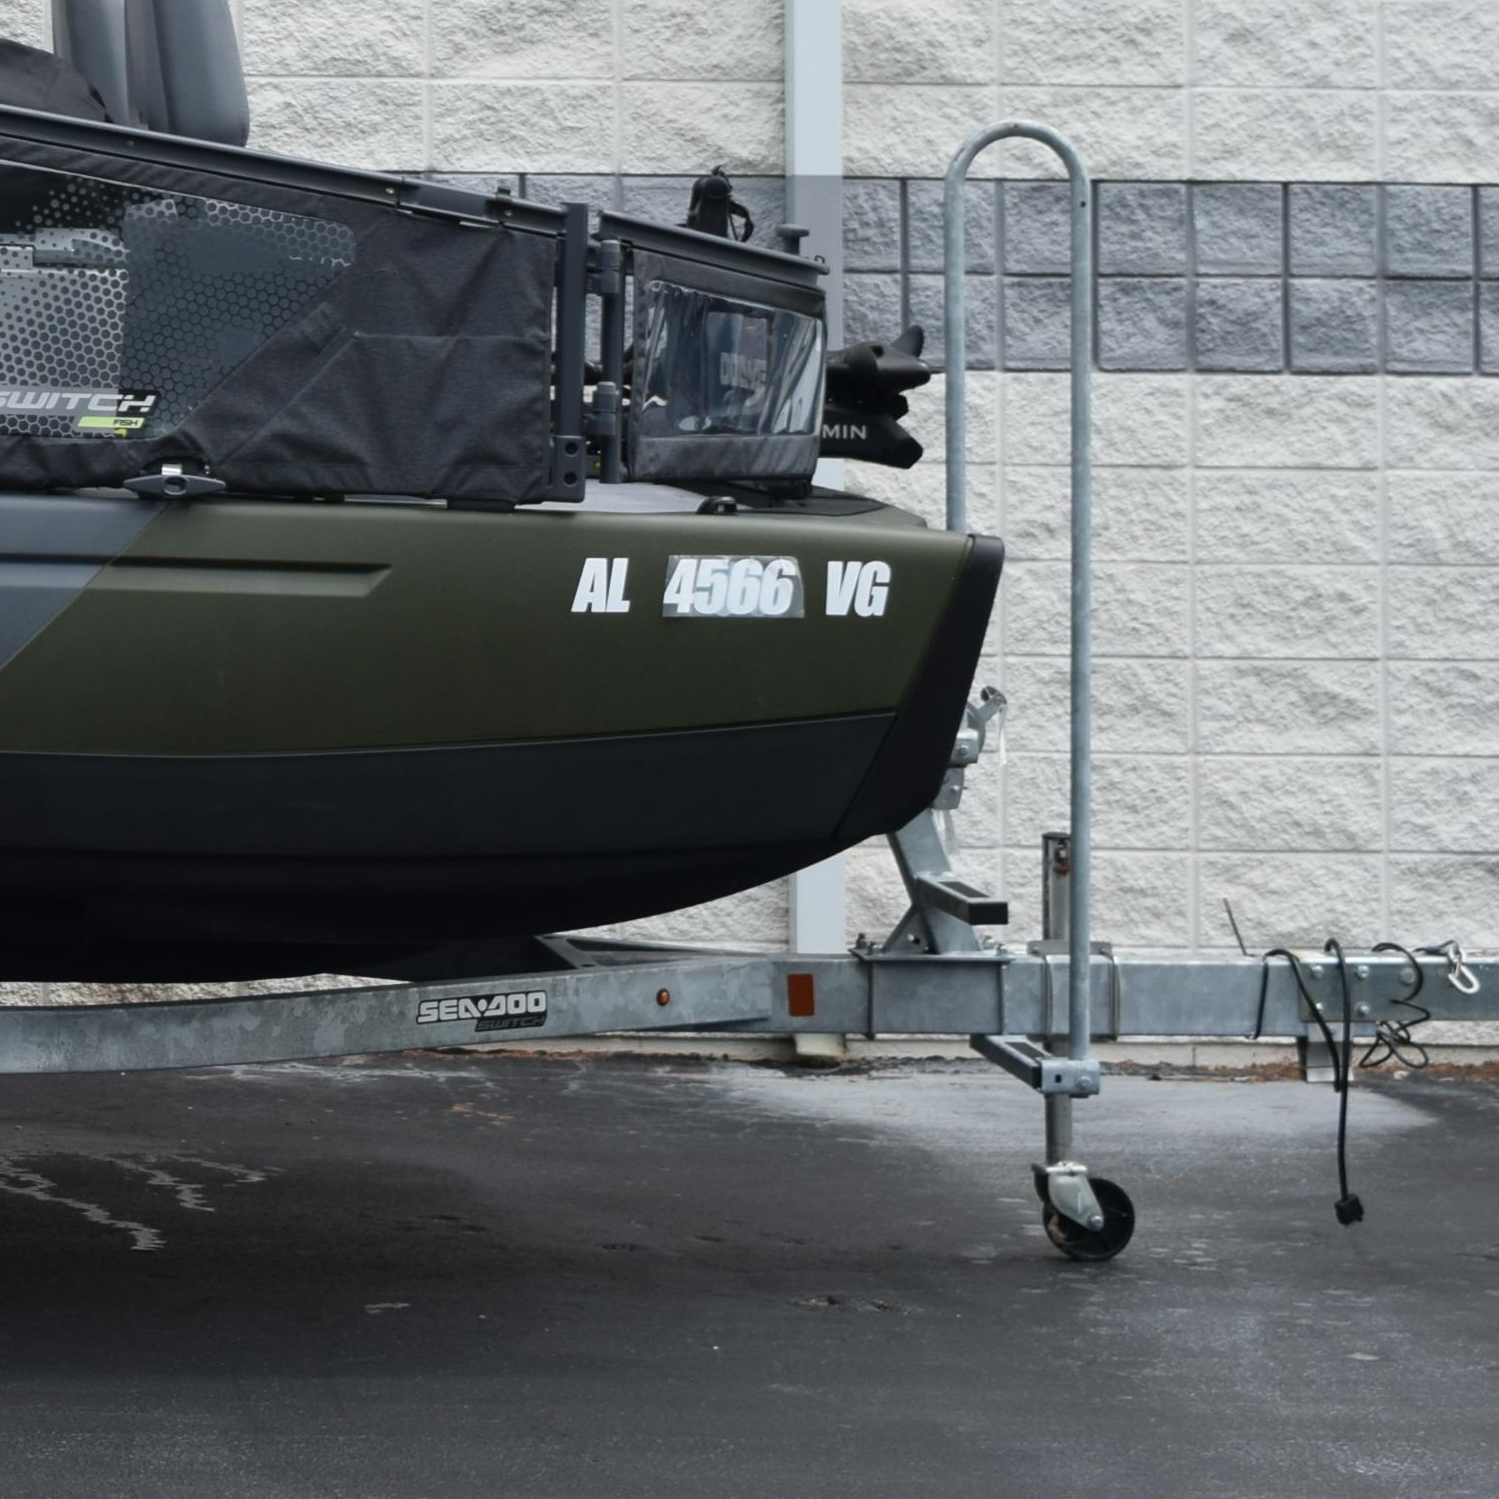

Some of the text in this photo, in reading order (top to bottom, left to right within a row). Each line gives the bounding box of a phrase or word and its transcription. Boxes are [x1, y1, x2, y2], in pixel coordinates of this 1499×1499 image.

[570, 557, 891, 617] AL 4566 VG
